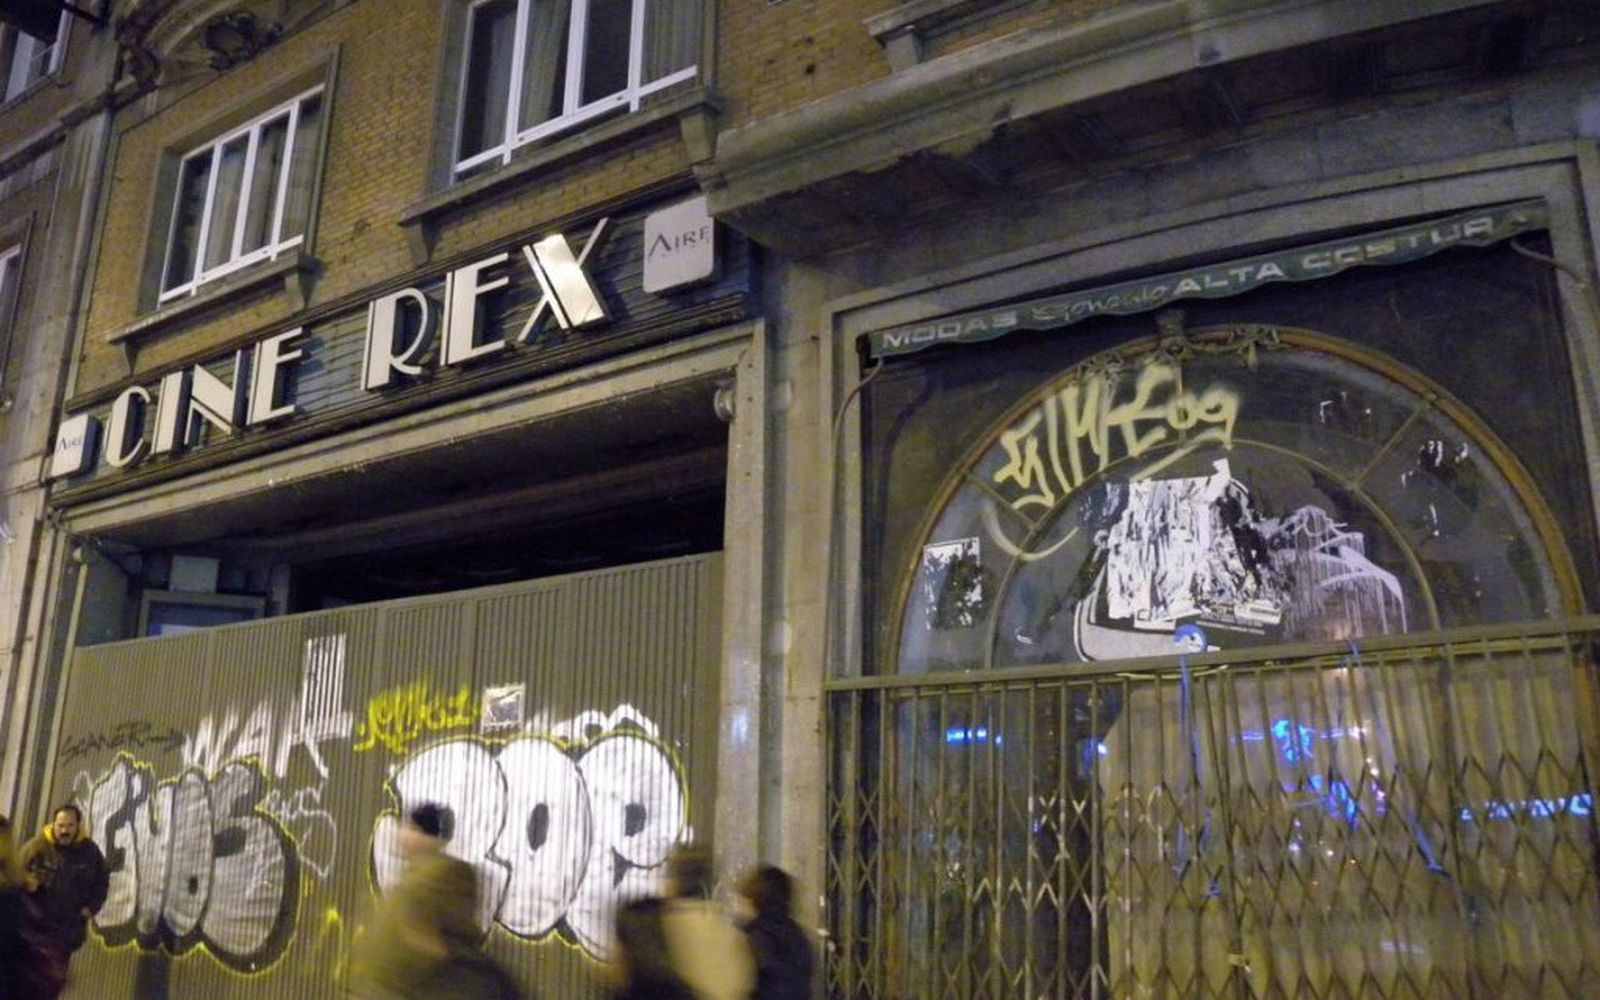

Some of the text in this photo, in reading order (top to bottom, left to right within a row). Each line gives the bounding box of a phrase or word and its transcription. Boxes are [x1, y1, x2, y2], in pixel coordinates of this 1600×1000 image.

[648, 226, 711, 262] AIRE
[102, 217, 608, 468] CINE REX
[882, 310, 1018, 349] MODAS
[1173, 261, 1286, 297] ALTA
